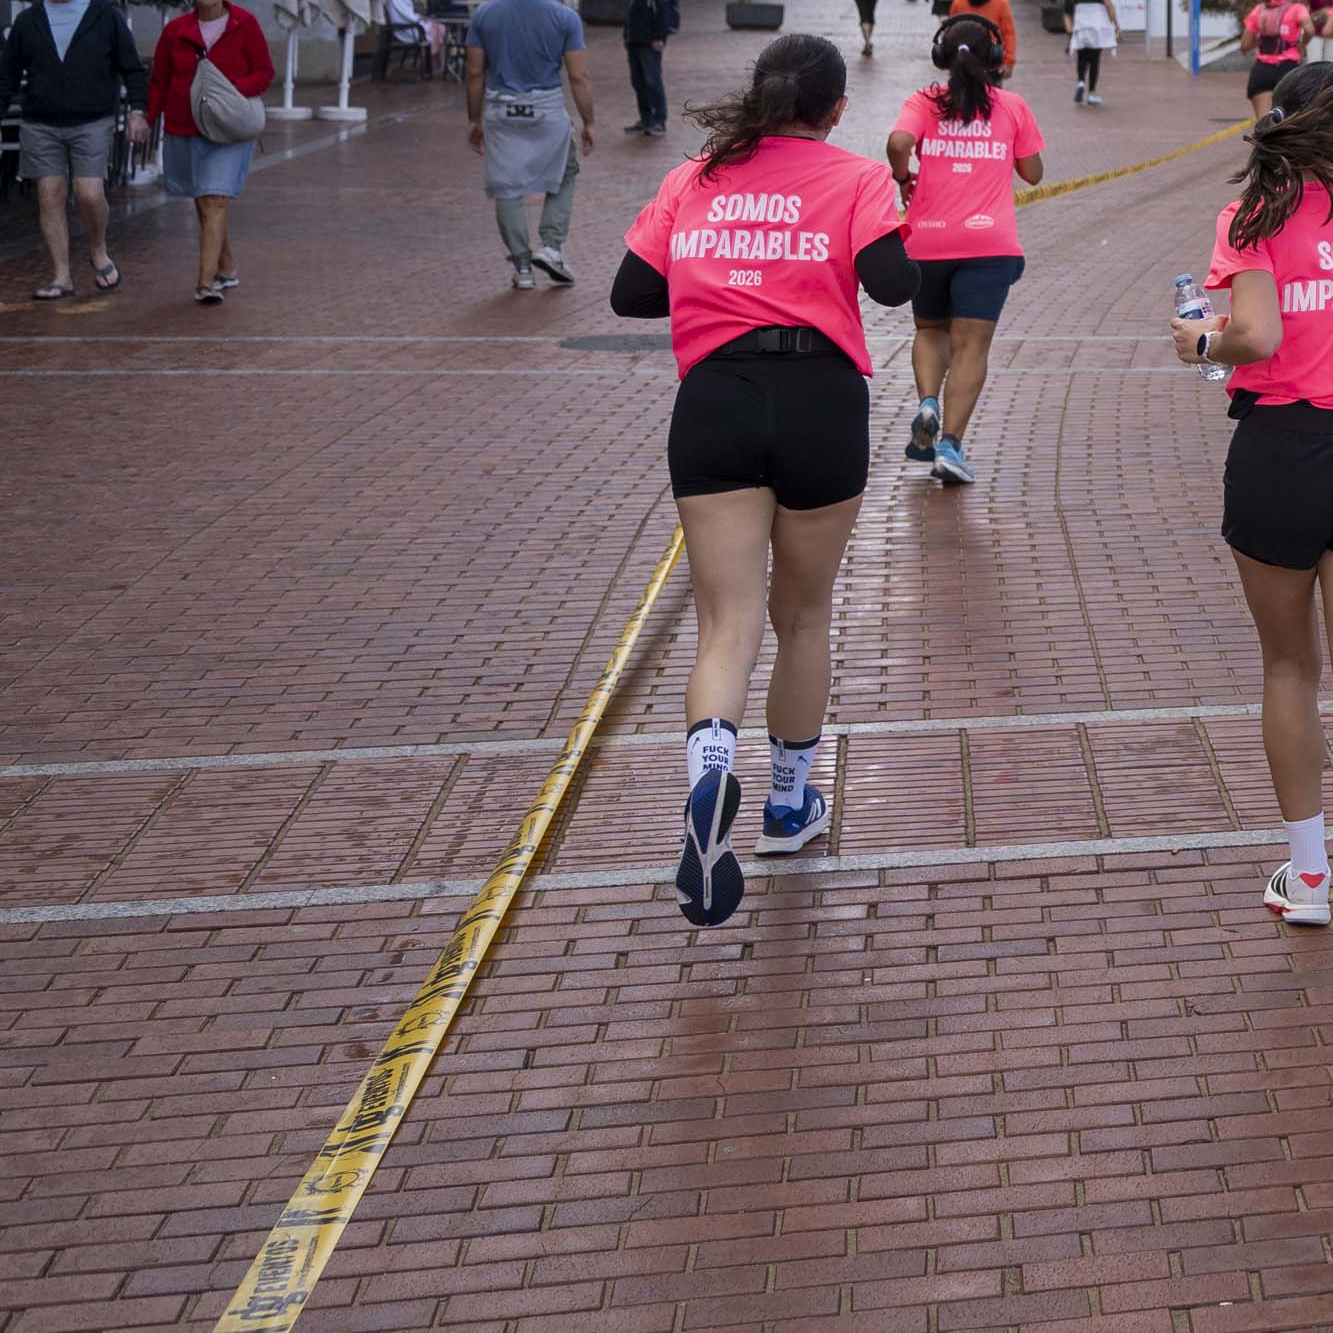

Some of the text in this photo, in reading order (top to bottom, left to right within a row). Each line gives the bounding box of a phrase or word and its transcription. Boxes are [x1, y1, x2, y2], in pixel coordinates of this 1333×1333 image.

[938, 119, 992, 137] SOMOS
[921, 138, 1008, 160] MPARABLES
[707, 193, 802, 224] SOMOS
[671, 229, 830, 262] IMPARABLES
[728, 270, 763, 286] 2026
[702, 745, 729, 756] FUCK
[702, 754, 729, 765] YOUR
[773, 763, 796, 775] FUCK
[772, 773, 796, 784] YOUR
[773, 783, 794, 793] MIND
